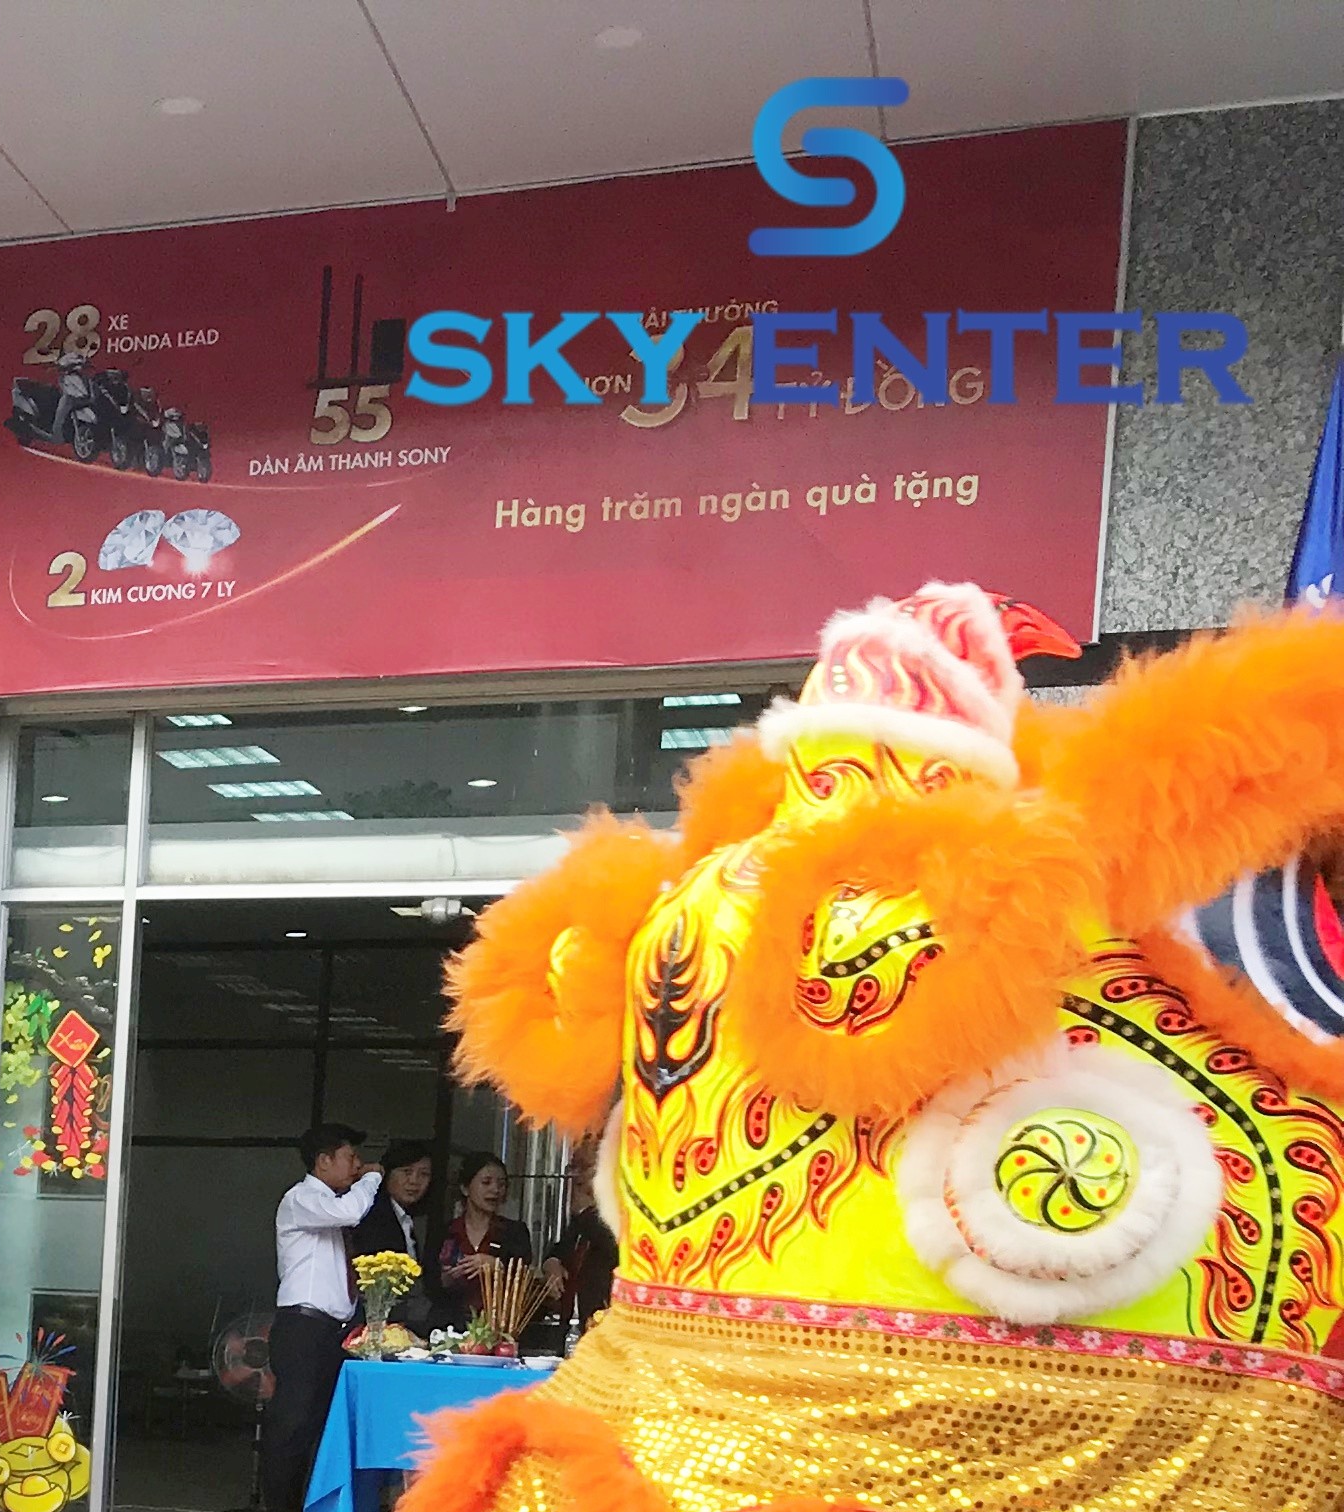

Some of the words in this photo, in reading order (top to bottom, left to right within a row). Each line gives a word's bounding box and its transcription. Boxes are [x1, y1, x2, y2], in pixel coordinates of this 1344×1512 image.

[23, 304, 101, 364] 28
[108, 313, 129, 331] XE
[106, 332, 172, 353] HONDA
[177, 328, 219, 348] LEAD
[311, 384, 393, 446] 55
[248, 454, 289, 477] DÀN
[293, 452, 324, 473] ÂM
[328, 450, 392, 471] THANH
[397, 446, 452, 467] SONY
[494, 498, 587, 534] Hàng
[601, 491, 683, 522] trăm
[697, 482, 791, 522] ngàn
[805, 474, 878, 516] quà
[892, 471, 981, 509] tặng
[47, 551, 87, 608] 2
[90, 587, 122, 605] KIM
[127, 583, 196, 603] CƯƠNG
[201, 582, 213, 598] 7
[217, 580, 236, 597] LY
